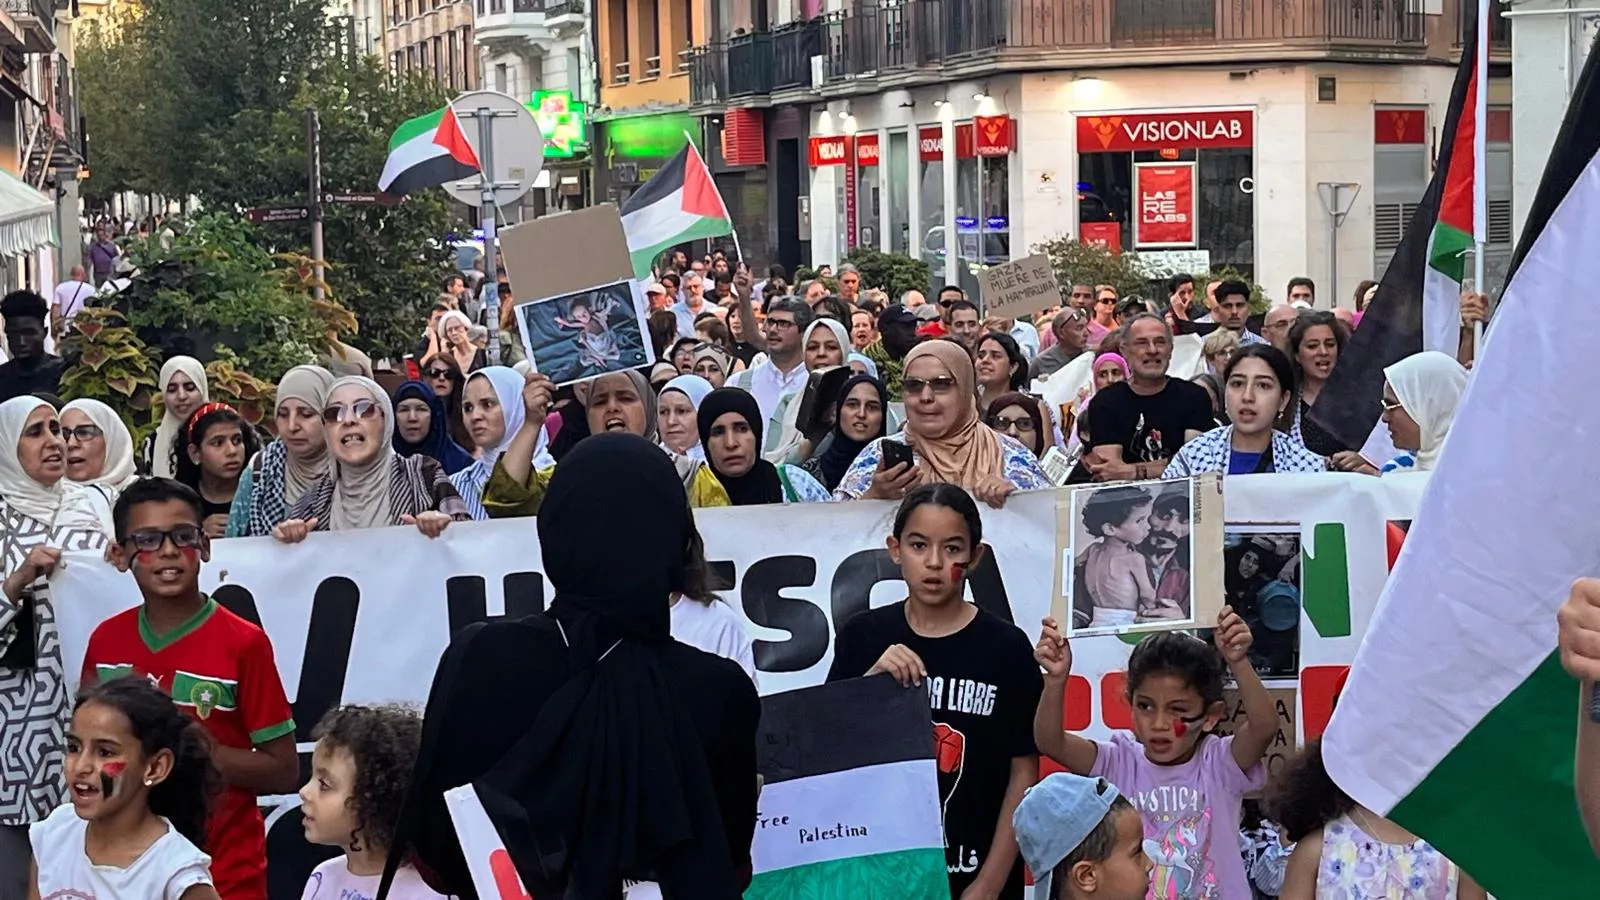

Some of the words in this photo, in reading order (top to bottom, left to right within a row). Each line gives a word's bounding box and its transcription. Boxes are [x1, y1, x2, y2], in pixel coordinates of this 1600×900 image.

[1122, 120, 1242, 142] VISIONLAB
[1142, 190, 1176, 201] LAS
[1142, 200, 1176, 214] RE
[1142, 213, 1187, 224] LABS
[987, 263, 1022, 281] GAZA
[990, 271, 1030, 292] MUERE
[1032, 267, 1047, 279] DE
[990, 296, 1004, 309] LA
[799, 822, 868, 844] Palestina
